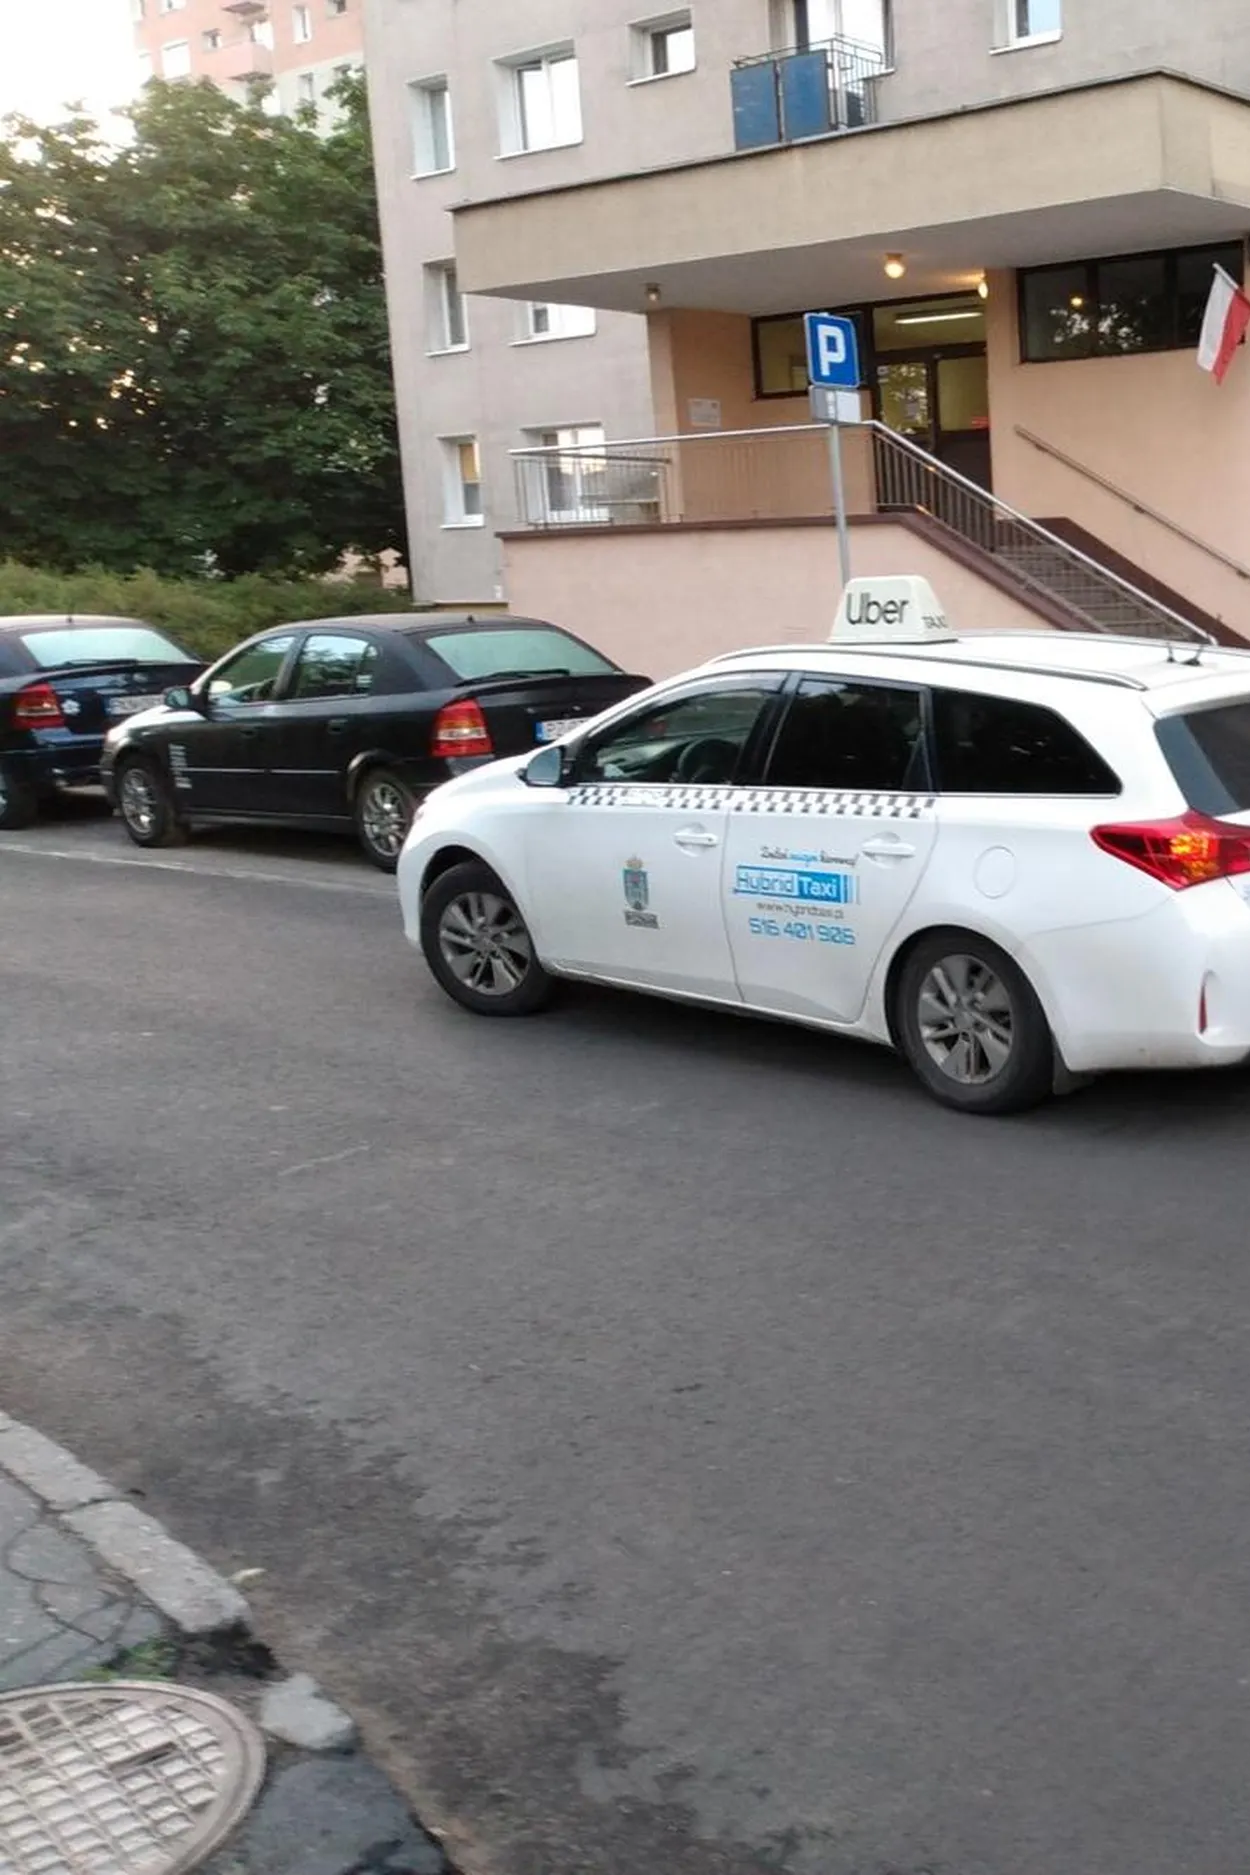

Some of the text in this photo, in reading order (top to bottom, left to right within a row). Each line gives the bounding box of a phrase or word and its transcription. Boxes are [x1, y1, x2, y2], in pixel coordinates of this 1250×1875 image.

[817, 324, 846, 376] P
[846, 591, 910, 625] Uber
[799, 876, 838, 897] Taxi
[749, 917, 780, 936] 516
